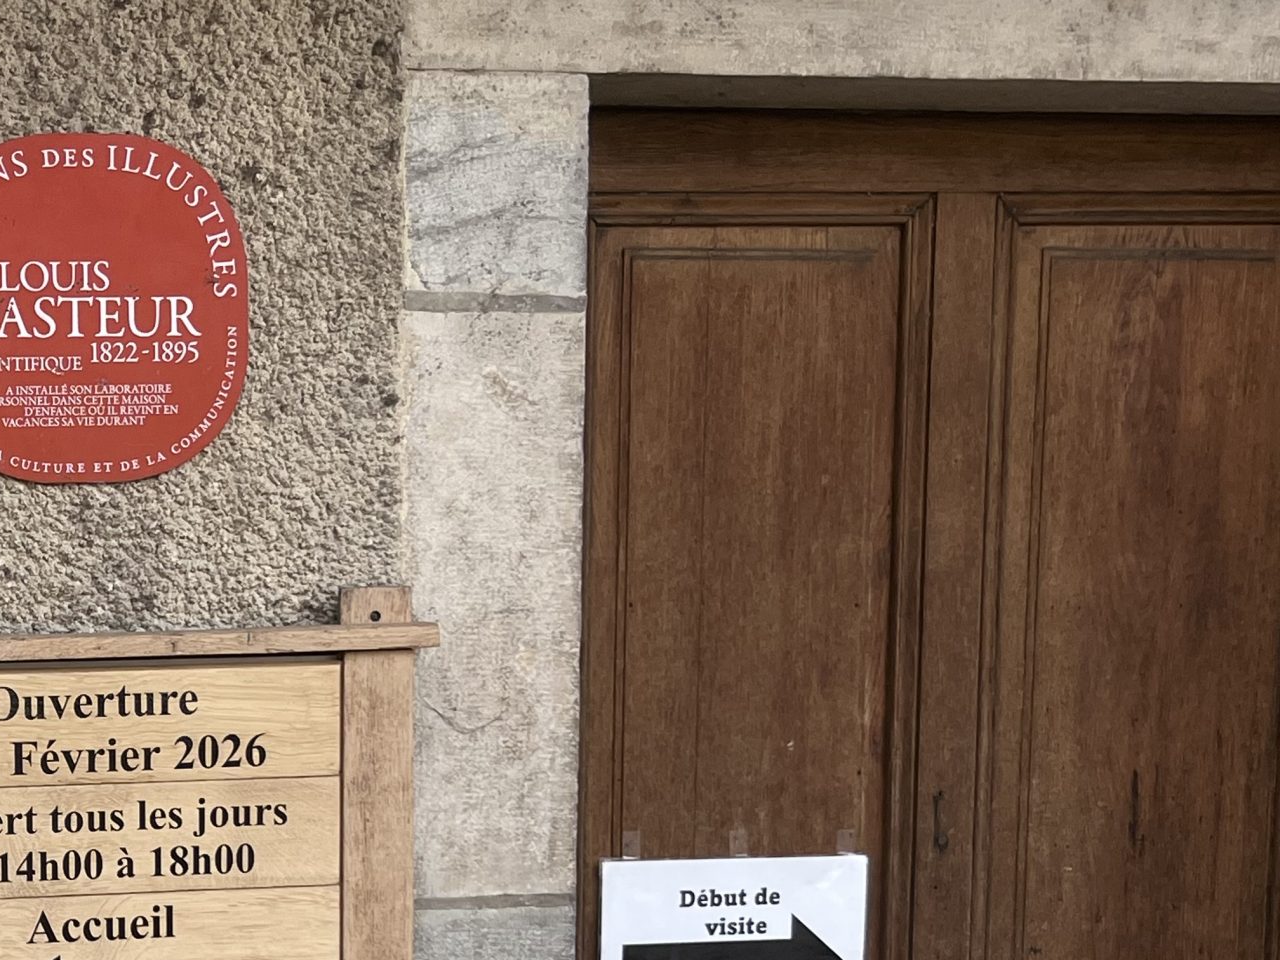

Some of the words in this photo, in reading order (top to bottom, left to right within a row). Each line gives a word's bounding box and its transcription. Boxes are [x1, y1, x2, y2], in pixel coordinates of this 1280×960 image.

[41, 148, 94, 168] DES
[107, 144, 238, 299] ILLUSTRES
[90, 341, 199, 364] 1822-1895
[6, 387, 15, 396] A
[16, 384, 68, 396] INSTALLÉ
[69, 385, 94, 395] SON
[94, 384, 173, 395] LABORATOIRE
[9, 455, 86, 474] CULTURE
[93, 461, 114, 473] ET
[119, 459, 141, 473] DE
[147, 451, 167, 467] LA
[170, 325, 238, 455] COMMUNICATION
[52, 396, 82, 406] DANS
[83, 395, 119, 405] CETTE
[121, 394, 166, 405] MAISON
[2, 417, 60, 427] VACANCES
[61, 417, 74, 426] SA
[77, 416, 96, 426] VIE
[97, 416, 146, 426] DURANT
[24, 406, 89, 417] D'ENFANCE
[90, 404, 105, 416] OÙ
[107, 406, 118, 415] IL
[119, 405, 162, 415] REVINT
[163, 405, 178, 415] EN
[12, 737, 161, 777] Février
[173, 733, 267, 771] 2026
[50, 804, 124, 833] tous
[137, 801, 183, 831] les
[193, 798, 288, 837] jours
[116, 848, 136, 879] à
[150, 843, 255, 878] 18h00
[679, 889, 746, 908] Début
[755, 887, 781, 905] de
[26, 905, 176, 944] Accueil
[705, 917, 767, 936] visite
